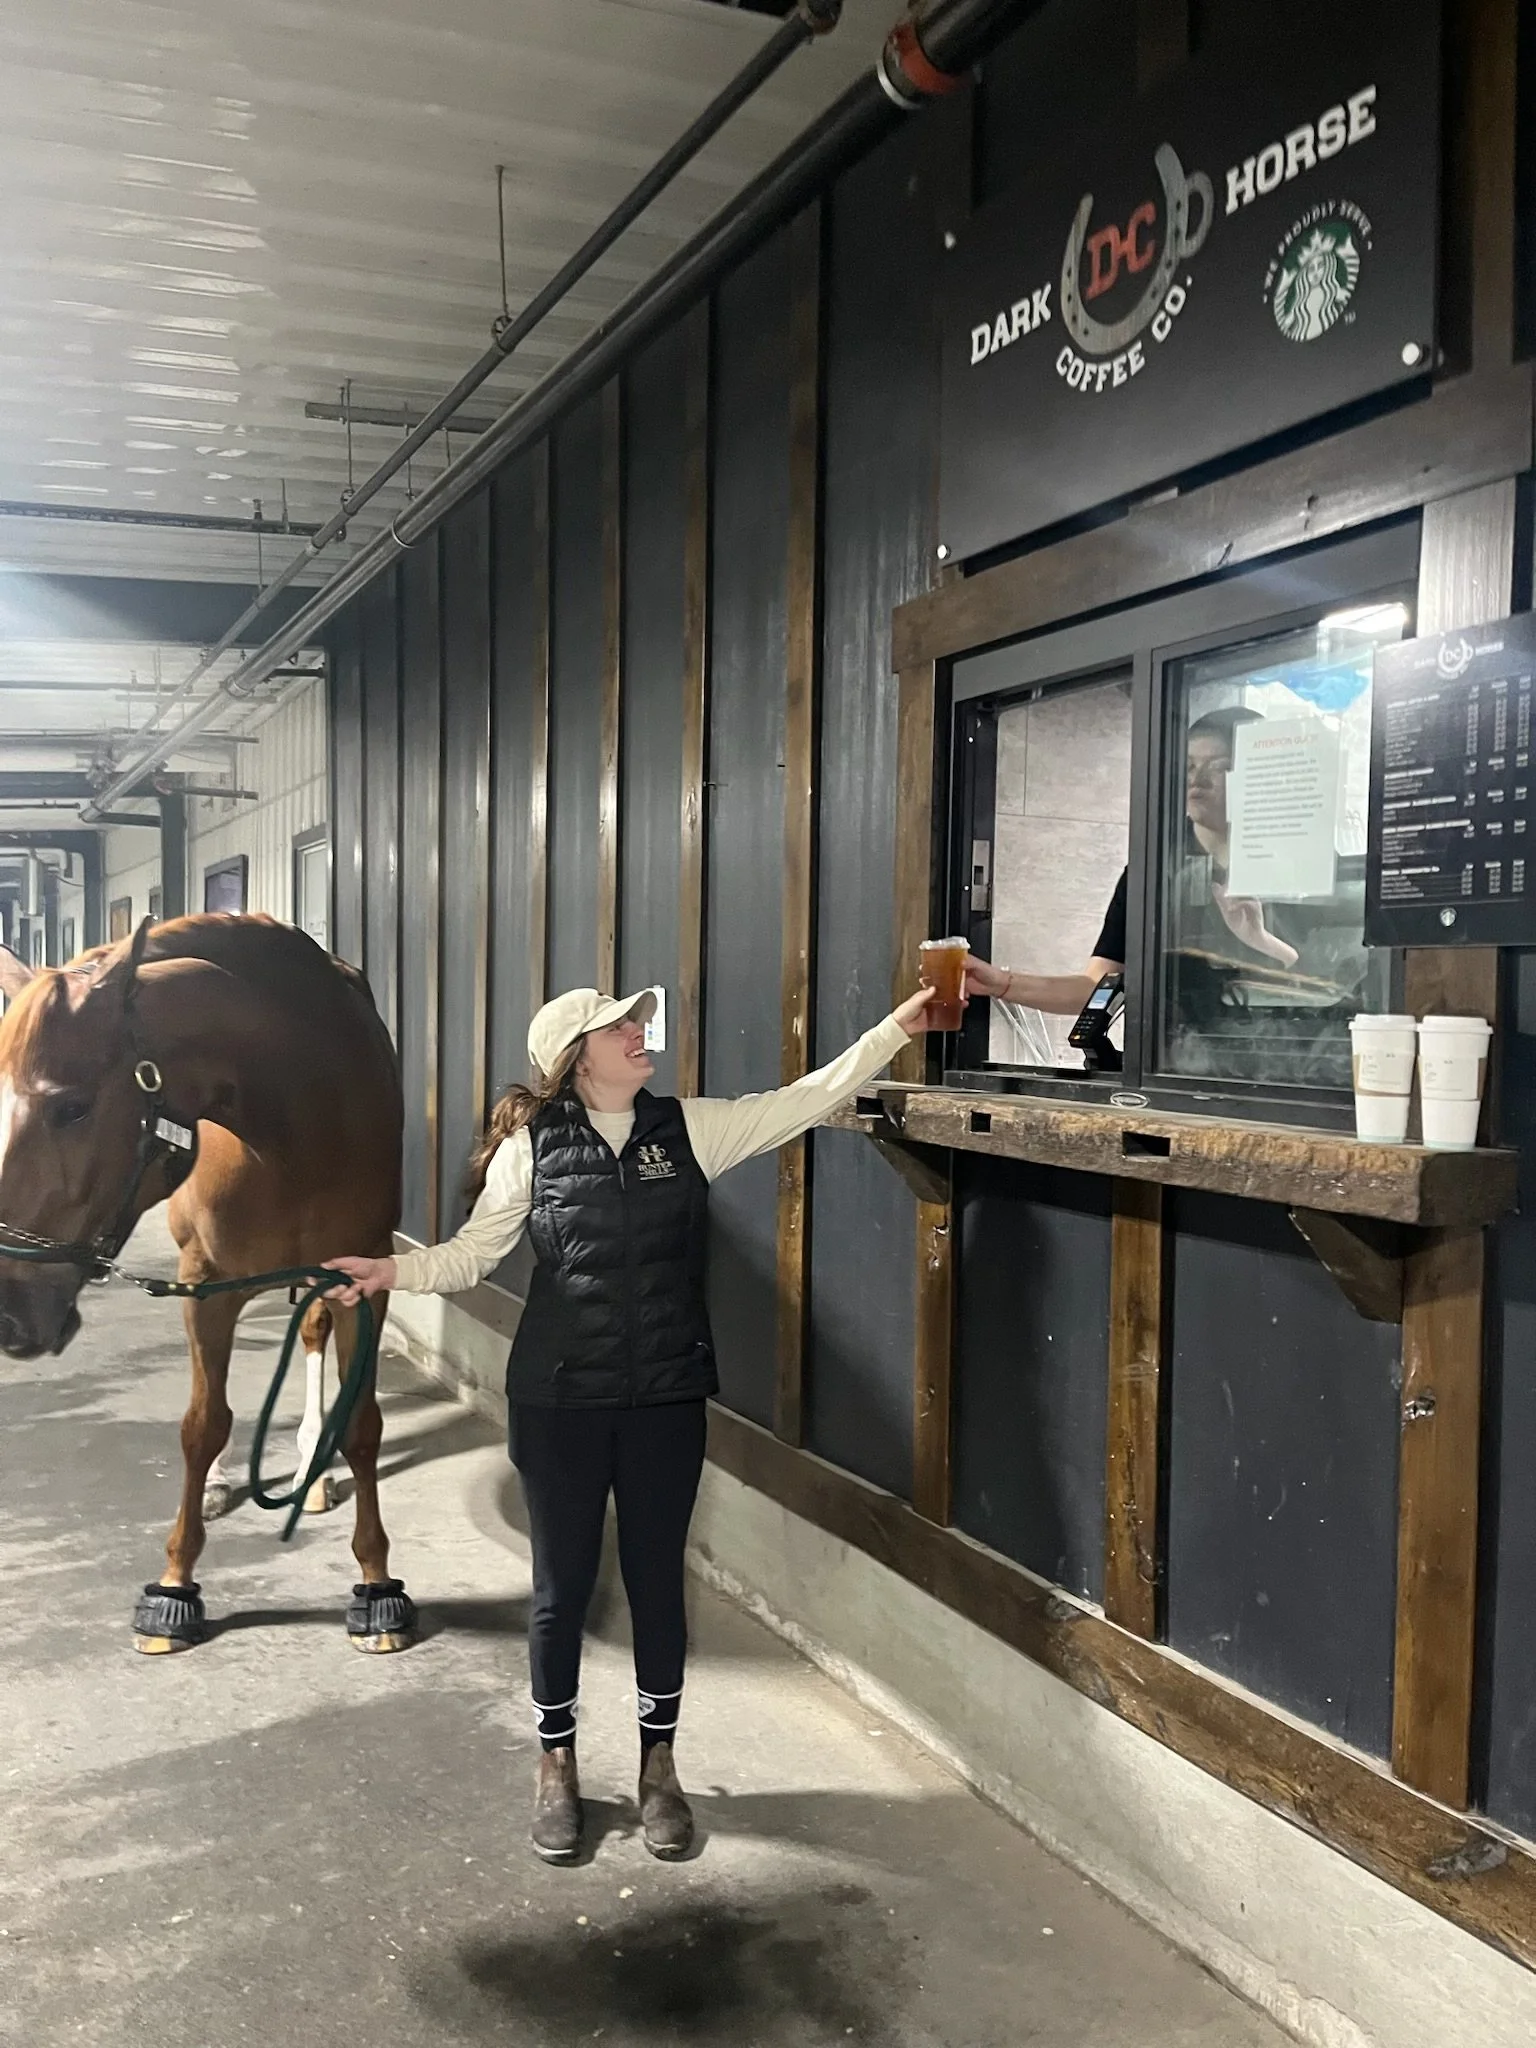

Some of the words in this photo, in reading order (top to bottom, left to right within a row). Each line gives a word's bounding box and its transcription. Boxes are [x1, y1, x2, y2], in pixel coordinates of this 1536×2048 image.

[971, 283, 1051, 365] DARK
[1226, 85, 1376, 215] HORSE
[1278, 199, 1336, 256] PROUDLY
[1056, 340, 1146, 392] COFFEE
[1152, 275, 1193, 343] CO.
